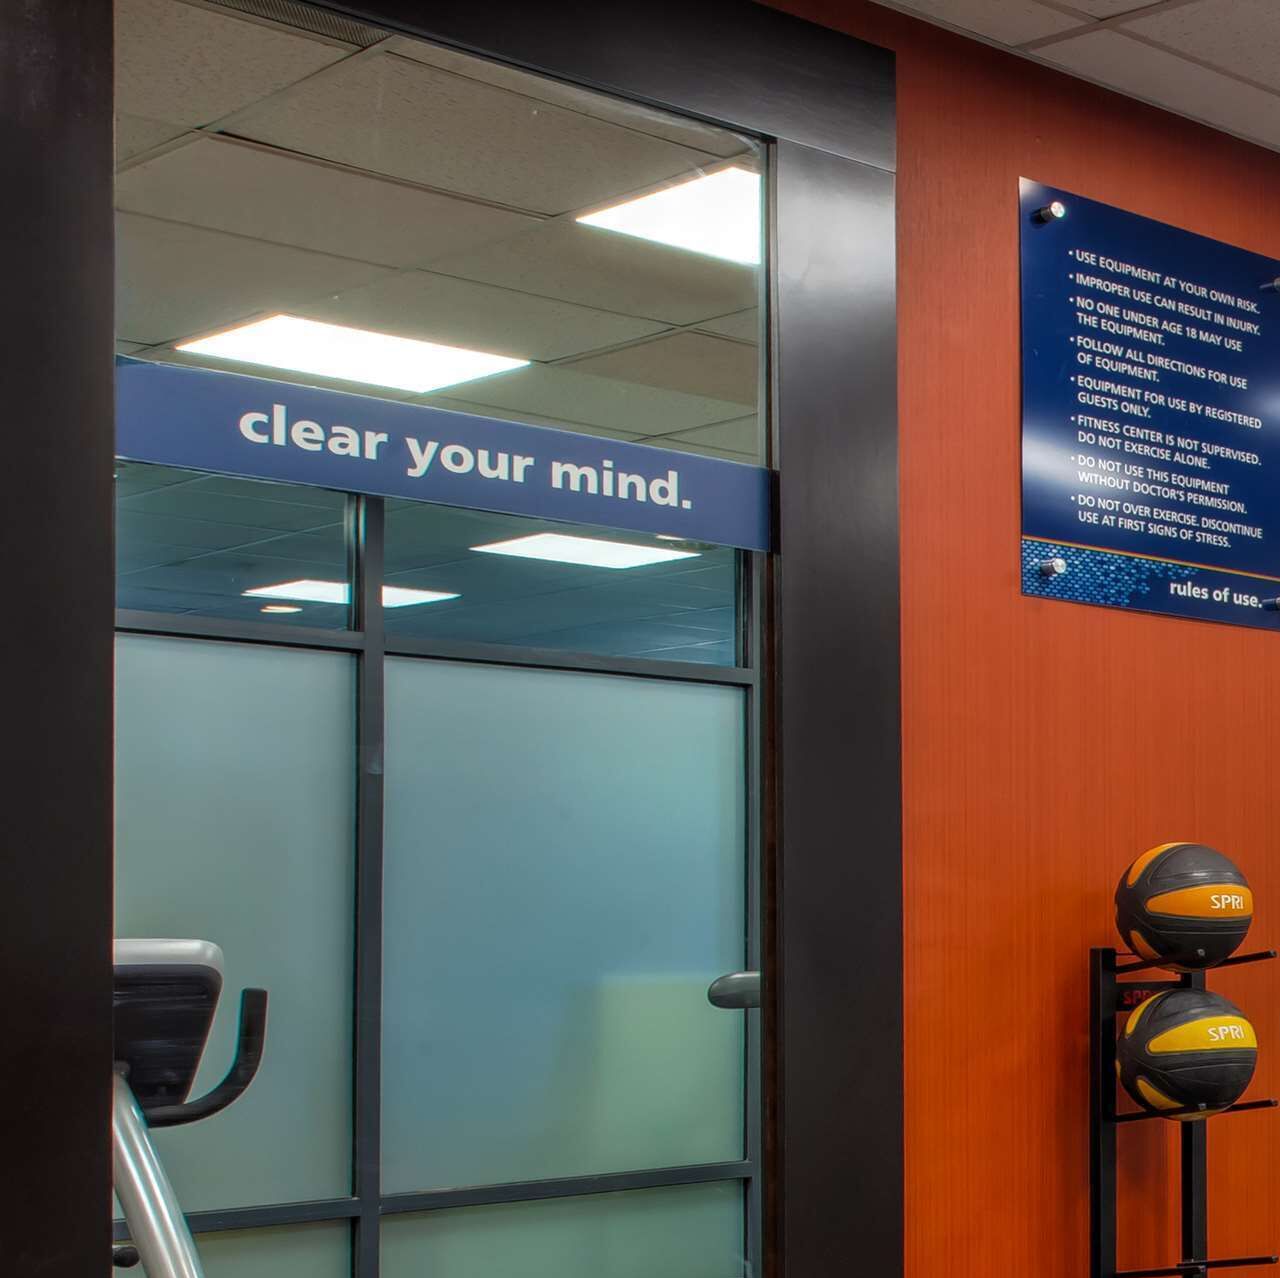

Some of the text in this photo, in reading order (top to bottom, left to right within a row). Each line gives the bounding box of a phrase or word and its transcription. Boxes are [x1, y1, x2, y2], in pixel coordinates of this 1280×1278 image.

[1076, 250, 1260, 314] USE EQUIPMENT AT YOUR OWN RISK.
[1076, 273, 1261, 336] IMPROPER USE CAN RESULT IN INJURY.
[1077, 297, 1242, 352] NO ONE UNDER AGE 18 MAY USE
[1077, 312, 1165, 346] THE EQUIPMENT.
[1077, 336, 1247, 389] FOLLOW ALL DIRECTIONS FOR USE
[1077, 352, 1160, 382] OF EQUIPMENT.
[1078, 375, 1262, 430] EQUIPMENT FOR USE BY REGISTERED
[1078, 391, 1151, 418] GUESTS ONLY.
[239, 404, 692, 510] clear your mind.
[1078, 415, 1262, 466] FITNESS CENTER IS NOT SUPERVISED.
[1078, 431, 1211, 470] DO NOT EXERCISE ALONE.
[1078, 455, 1229, 496] DO NOT USE THIS EQUIPMENT
[1078, 471, 1130, 491] WITHOUT
[1187, 492, 1248, 514] PERMISSION.
[1078, 495, 1263, 539] DO NOT OVER EXERCISE. DISCONTINUE
[1078, 510, 1231, 548] USE AT FIRST SIGNS OF STRESS.
[1170, 582, 1262, 608] rules of use.
[1210, 895, 1244, 909] SPRI
[1208, 1026, 1244, 1041] SPRI
